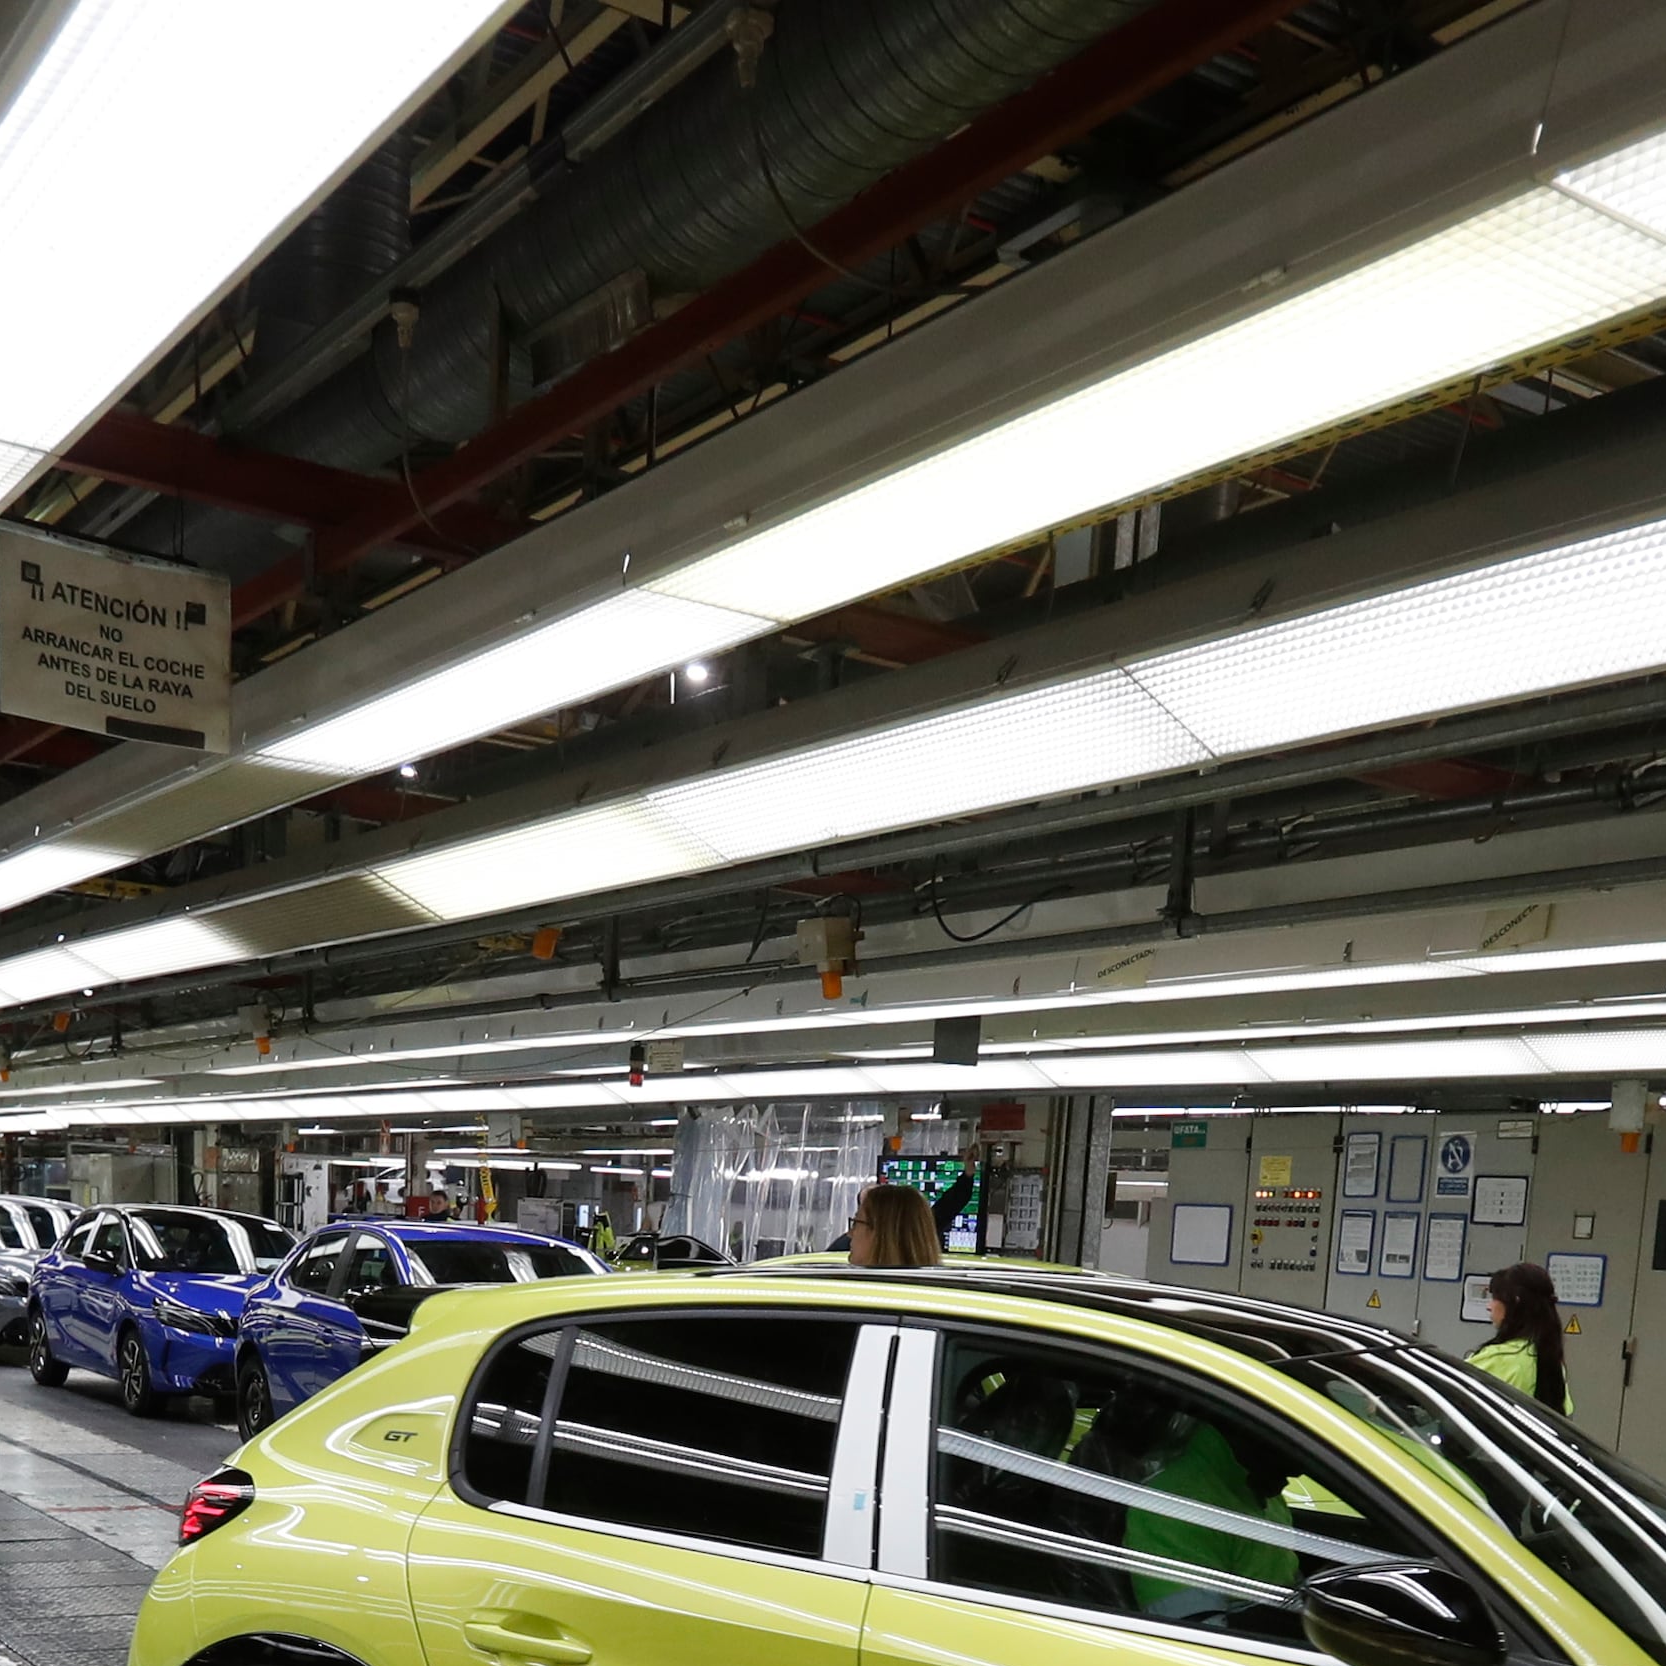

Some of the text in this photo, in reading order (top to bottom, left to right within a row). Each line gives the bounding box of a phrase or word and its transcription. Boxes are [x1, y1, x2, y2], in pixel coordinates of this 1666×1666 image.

[52, 581, 167, 627] ATENCIÓN
[21, 625, 205, 680] ARRANCAR EL COCHE
[99, 624, 123, 643] NO
[38, 653, 193, 699] ANTES DE LA RAYA
[65, 681, 156, 714] DEL SUELO
[384, 1430, 418, 1442] GT
